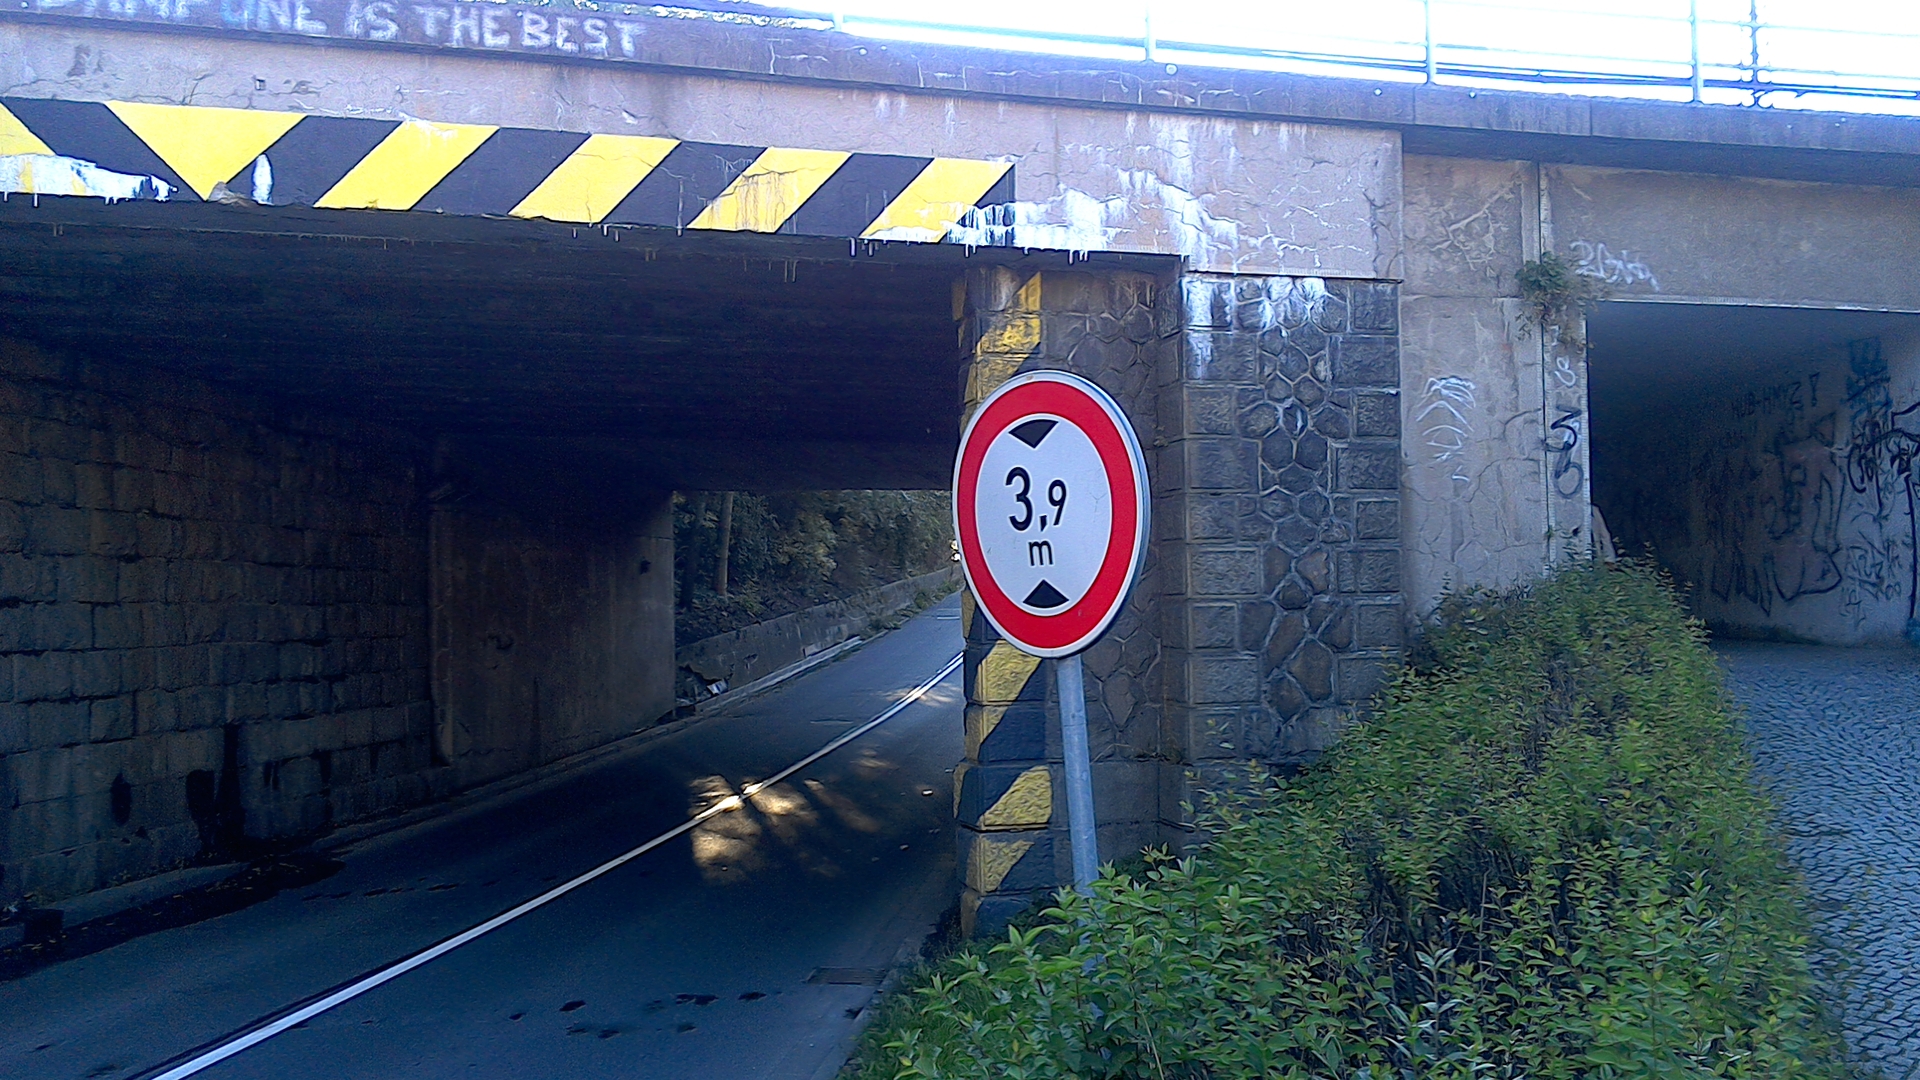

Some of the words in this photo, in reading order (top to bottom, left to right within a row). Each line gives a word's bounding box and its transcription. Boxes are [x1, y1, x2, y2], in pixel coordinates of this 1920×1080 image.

[345, 3, 400, 41] IS
[414, 5, 511, 47] THE
[520, 11, 647, 57] BEST
[1005, 466, 1067, 532] 3,9
[1029, 540, 1053, 566] m
